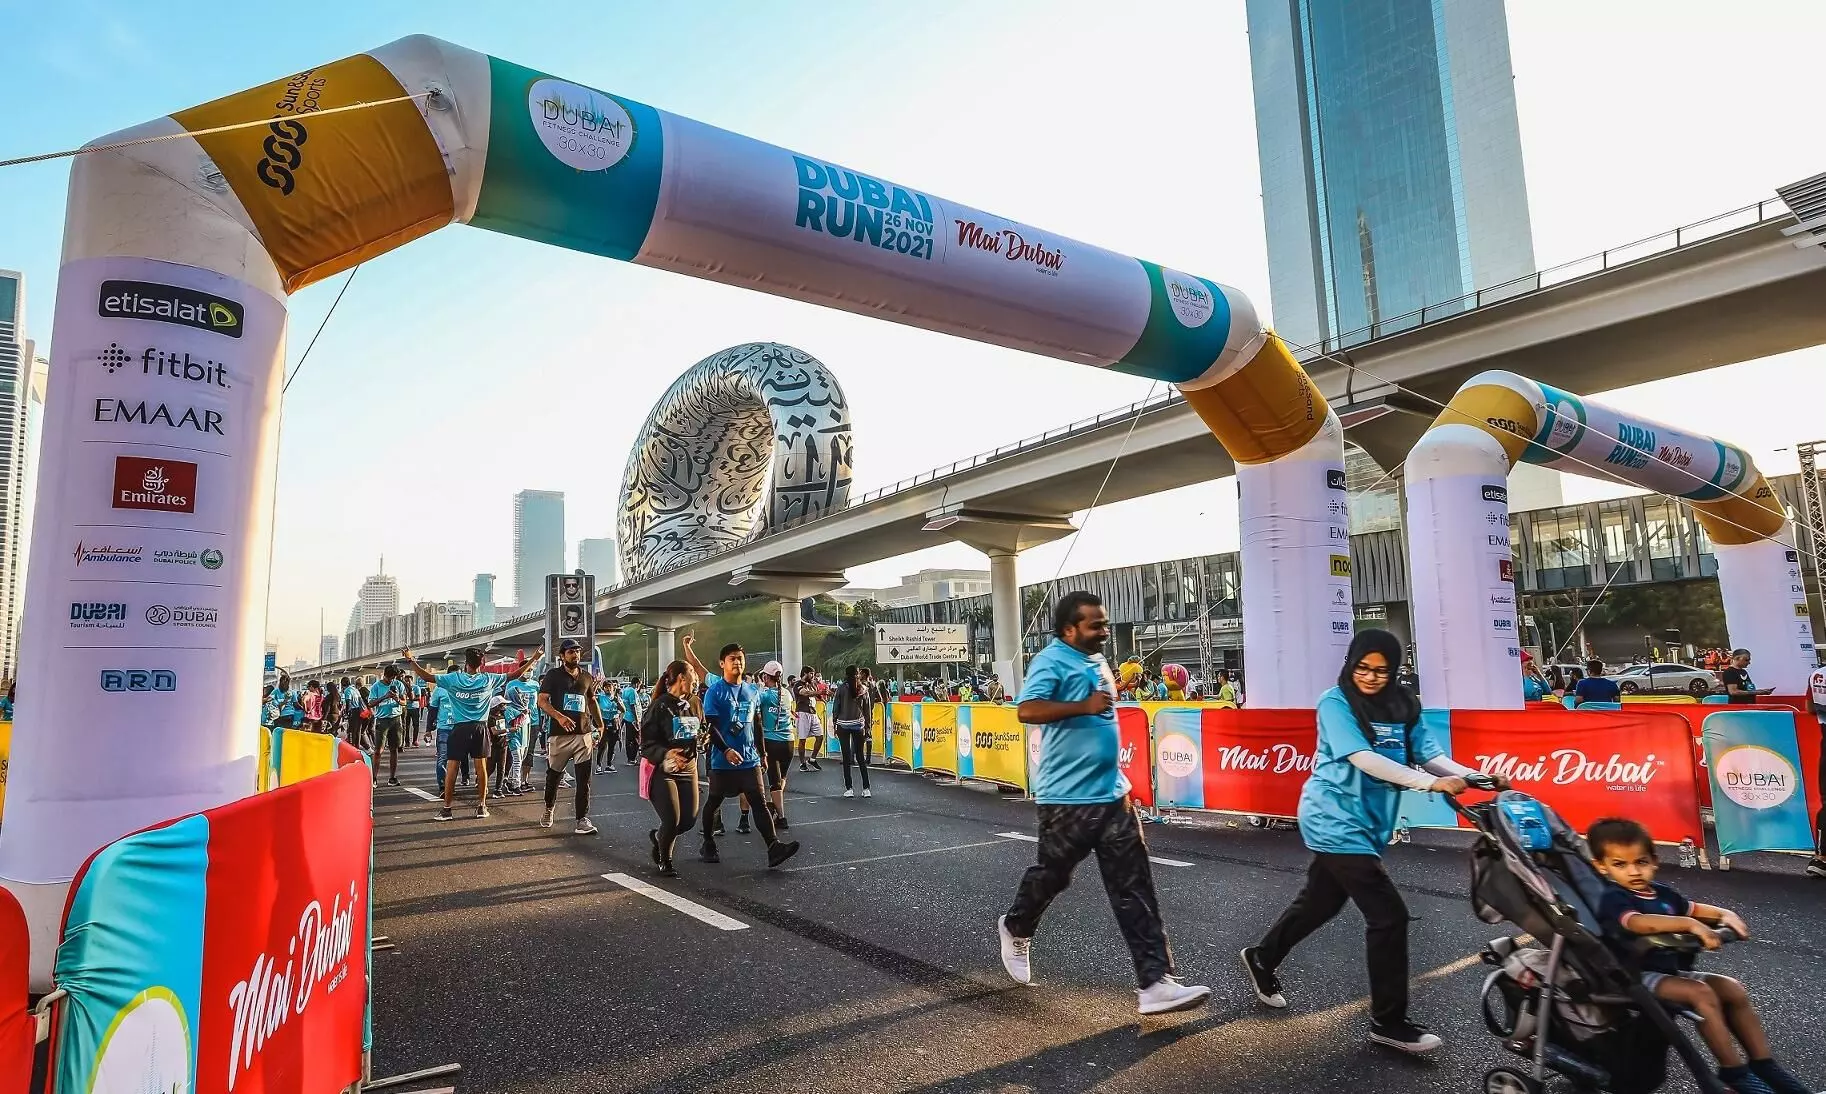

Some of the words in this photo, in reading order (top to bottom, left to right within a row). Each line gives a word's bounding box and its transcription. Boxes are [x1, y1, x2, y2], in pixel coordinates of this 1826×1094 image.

[543, 99, 621, 140] DUBAI
[542, 120, 576, 135] FITNESS
[578, 131, 620, 148] CHALLENGE
[558, 135, 606, 160] 30x30
[792, 155, 934, 224] DUBAI
[794, 188, 885, 247] RUN
[884, 212, 902, 228] 26
[905, 216, 933, 237] NOV
[880, 227, 934, 261] 2021
[954, 219, 1004, 254] Mai
[1003, 230, 1064, 271] Dubai
[1171, 283, 1209, 305] DUBAI
[104, 292, 207, 324] etisalat
[94, 398, 225, 436] EMAAR
[1618, 422, 1656, 453] DUBAI
[121, 489, 187, 507] Emirates
[83, 553, 142, 563] Ambulance
[70, 602, 127, 621] DUBAI
[173, 610, 218, 623] DUBAI
[100, 669, 177, 692] ARN
[994, 731, 1020, 742] Sun&Sand
[994, 742, 1009, 751] Sports
[1162, 750, 1193, 763] DUBAI
[1218, 745, 1271, 770] Mai
[1475, 753, 1549, 782] Mai
[1551, 749, 1657, 785] Dubai
[1635, 784, 1647, 793] life
[1726, 772, 1785, 787] DUBAI
[1741, 792, 1776, 801] 30x30
[229, 936, 296, 1093] Mai
[296, 880, 356, 1014] Dubai
